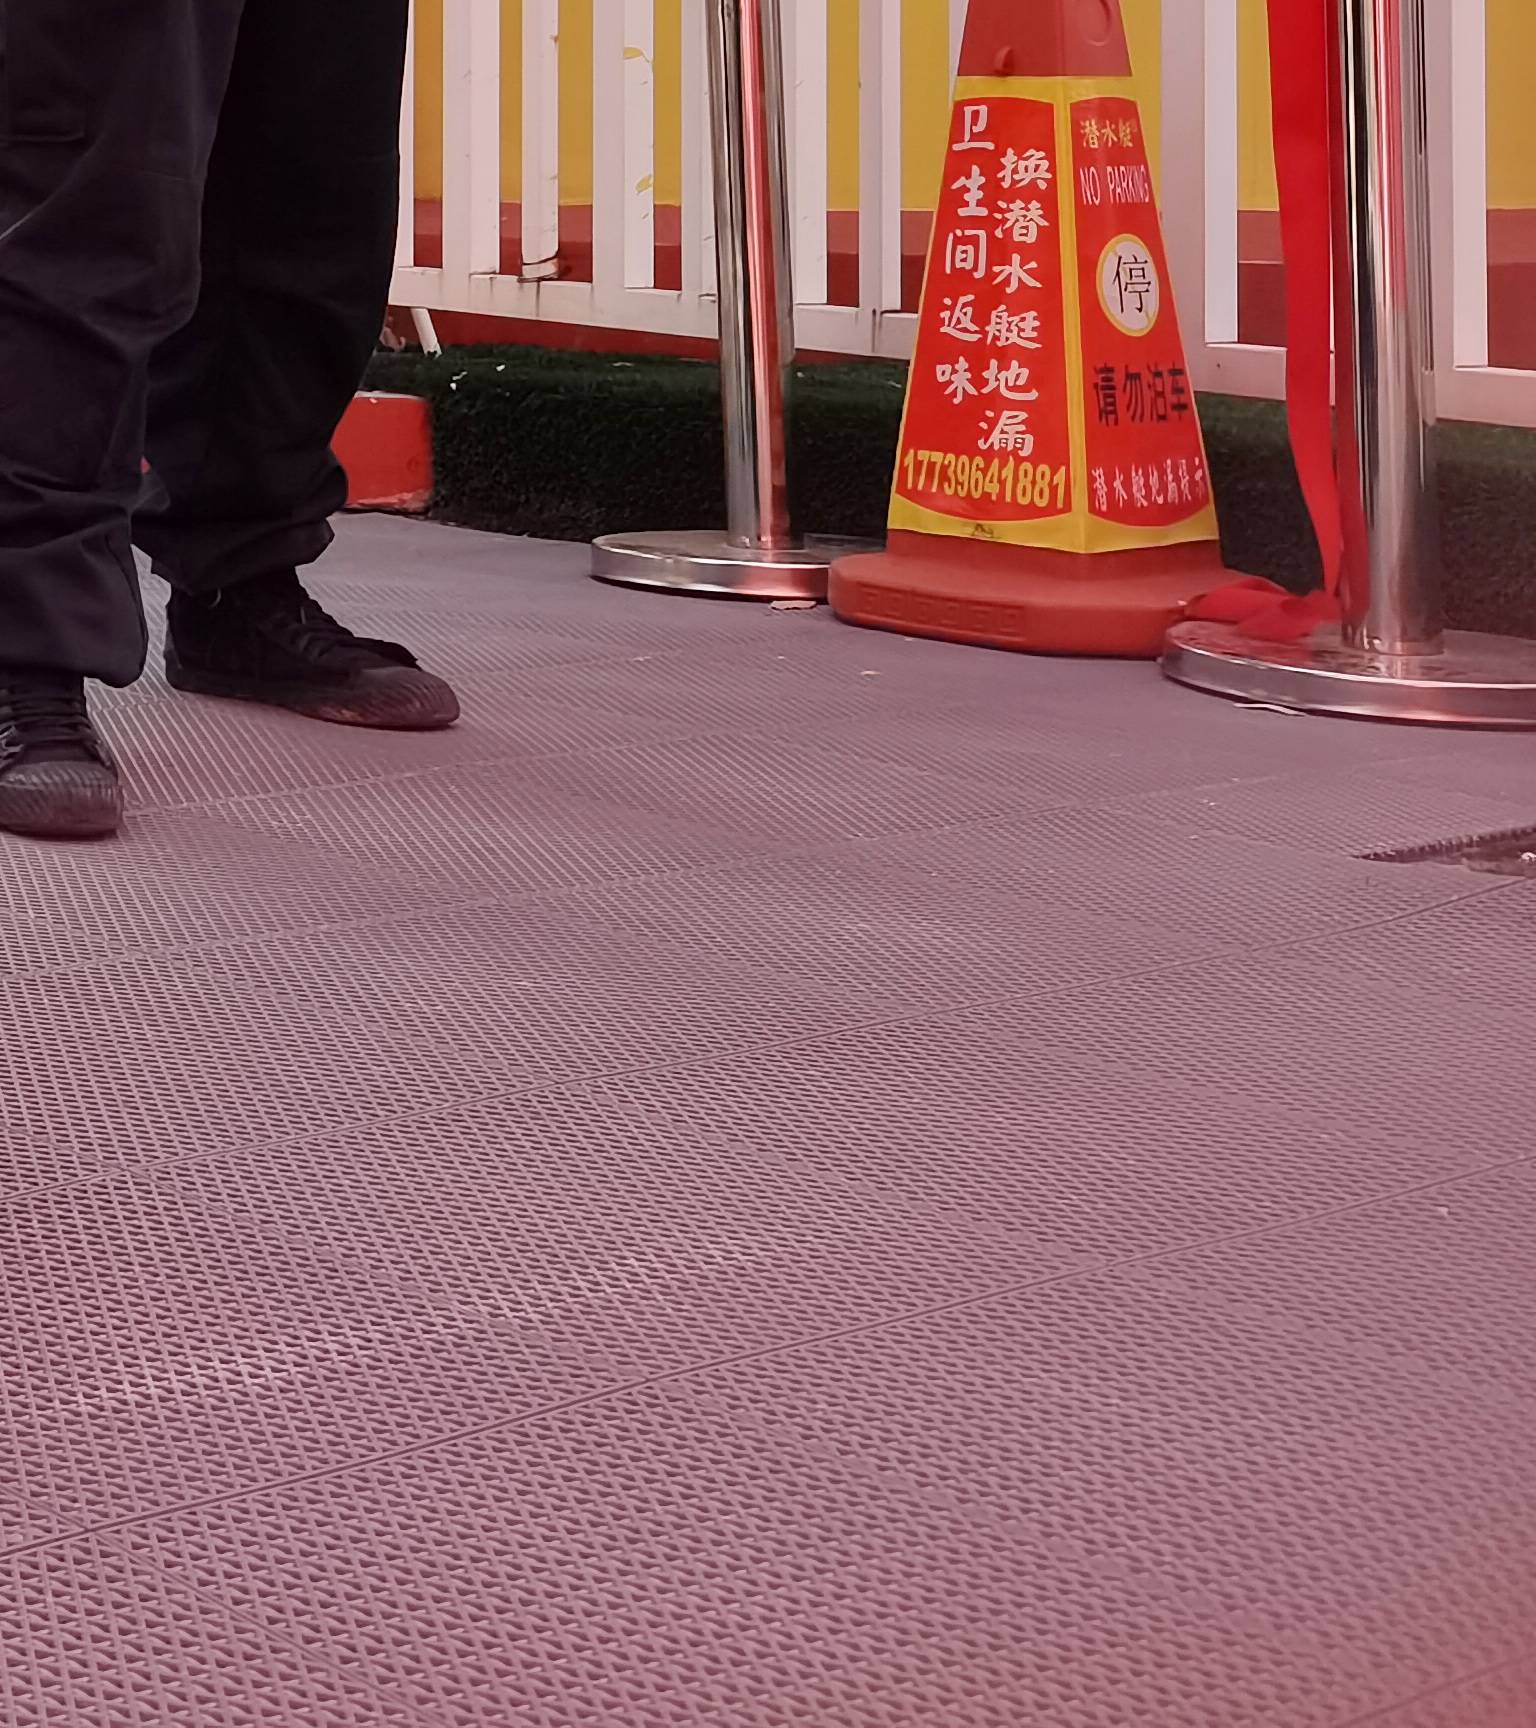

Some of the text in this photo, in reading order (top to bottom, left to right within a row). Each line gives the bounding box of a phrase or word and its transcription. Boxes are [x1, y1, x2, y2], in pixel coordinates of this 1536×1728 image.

[1079, 164, 1149, 206] NO PARKING
[935, 104, 994, 405] 卫生间返味
[1112, 254, 1153, 315] 停
[977, 148, 1053, 457] 换潜水艇地漏
[1092, 362, 1189, 427] 请勿泊车
[903, 449, 1066, 509] 17739641881
